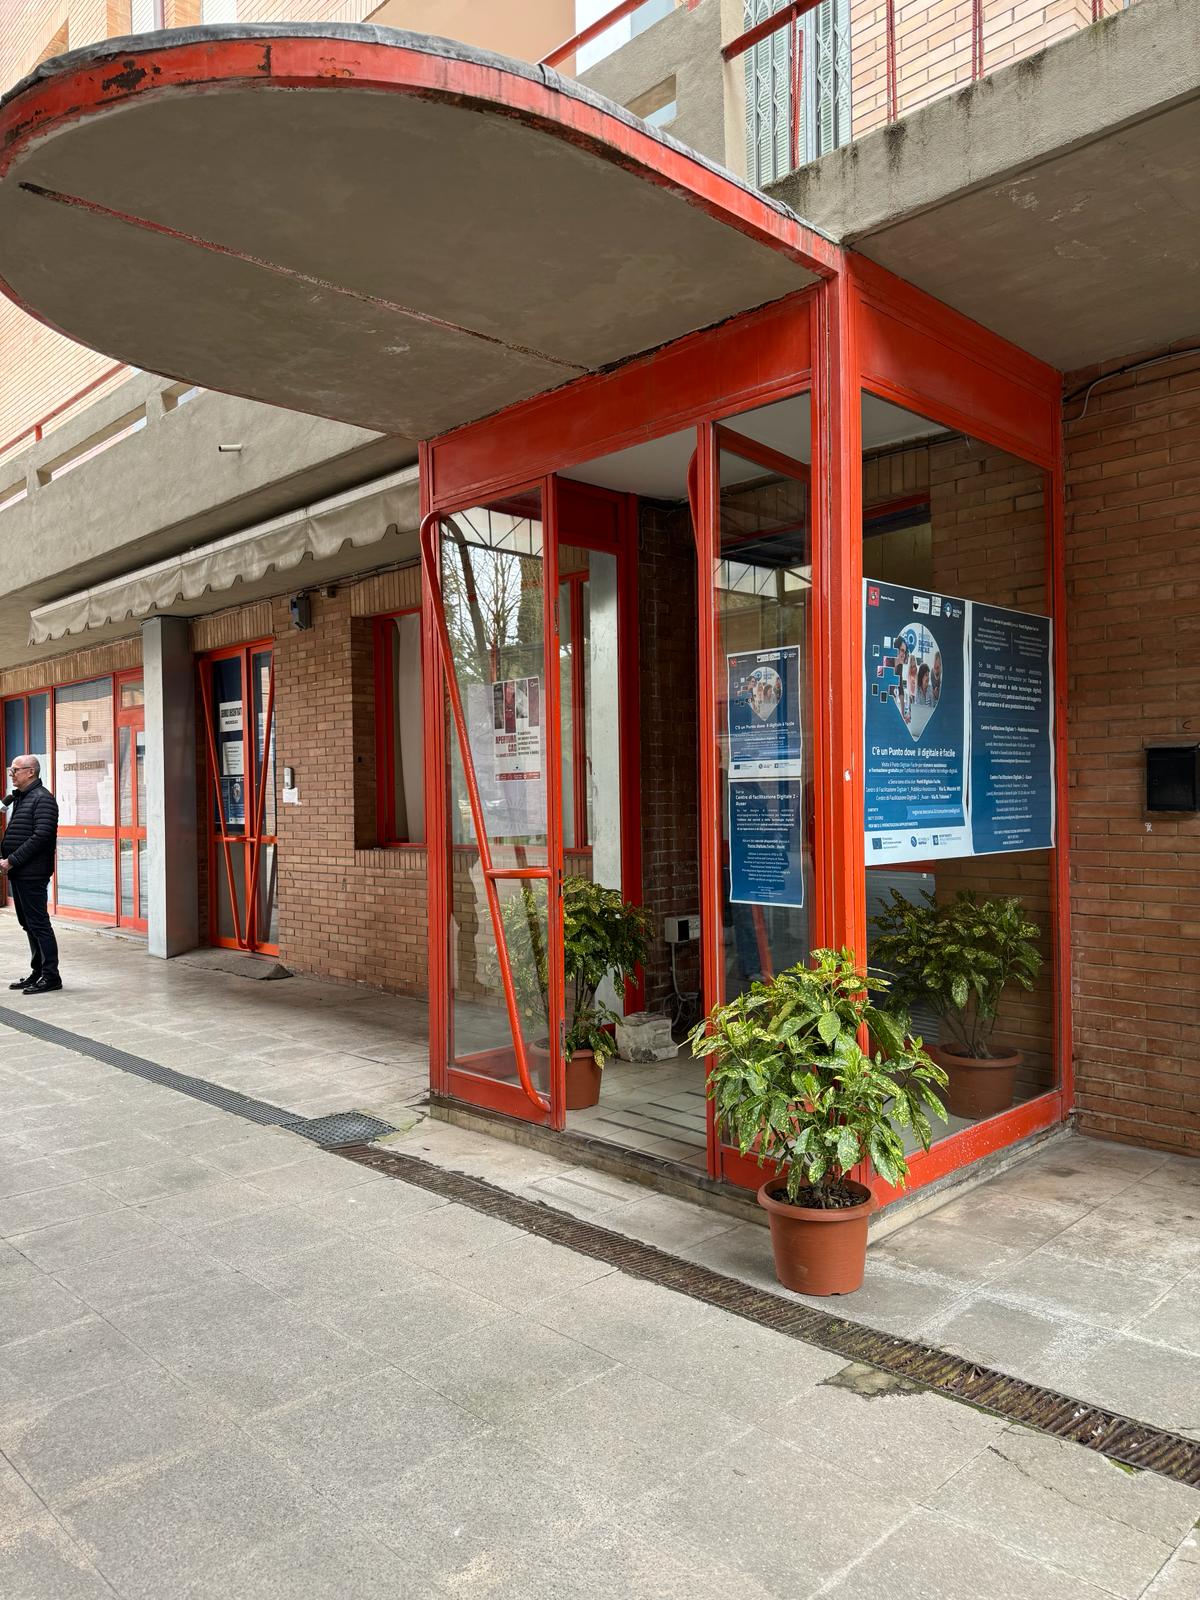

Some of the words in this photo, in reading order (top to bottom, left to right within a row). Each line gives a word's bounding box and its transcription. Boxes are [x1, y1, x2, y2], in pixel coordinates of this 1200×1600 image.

[872, 747, 880, 756] C'è
[881, 748, 888, 756] un
[889, 747, 903, 756] Punto
[904, 748, 915, 756] dove
[922, 748, 939, 758] digitale
[943, 748, 955, 757] facile
